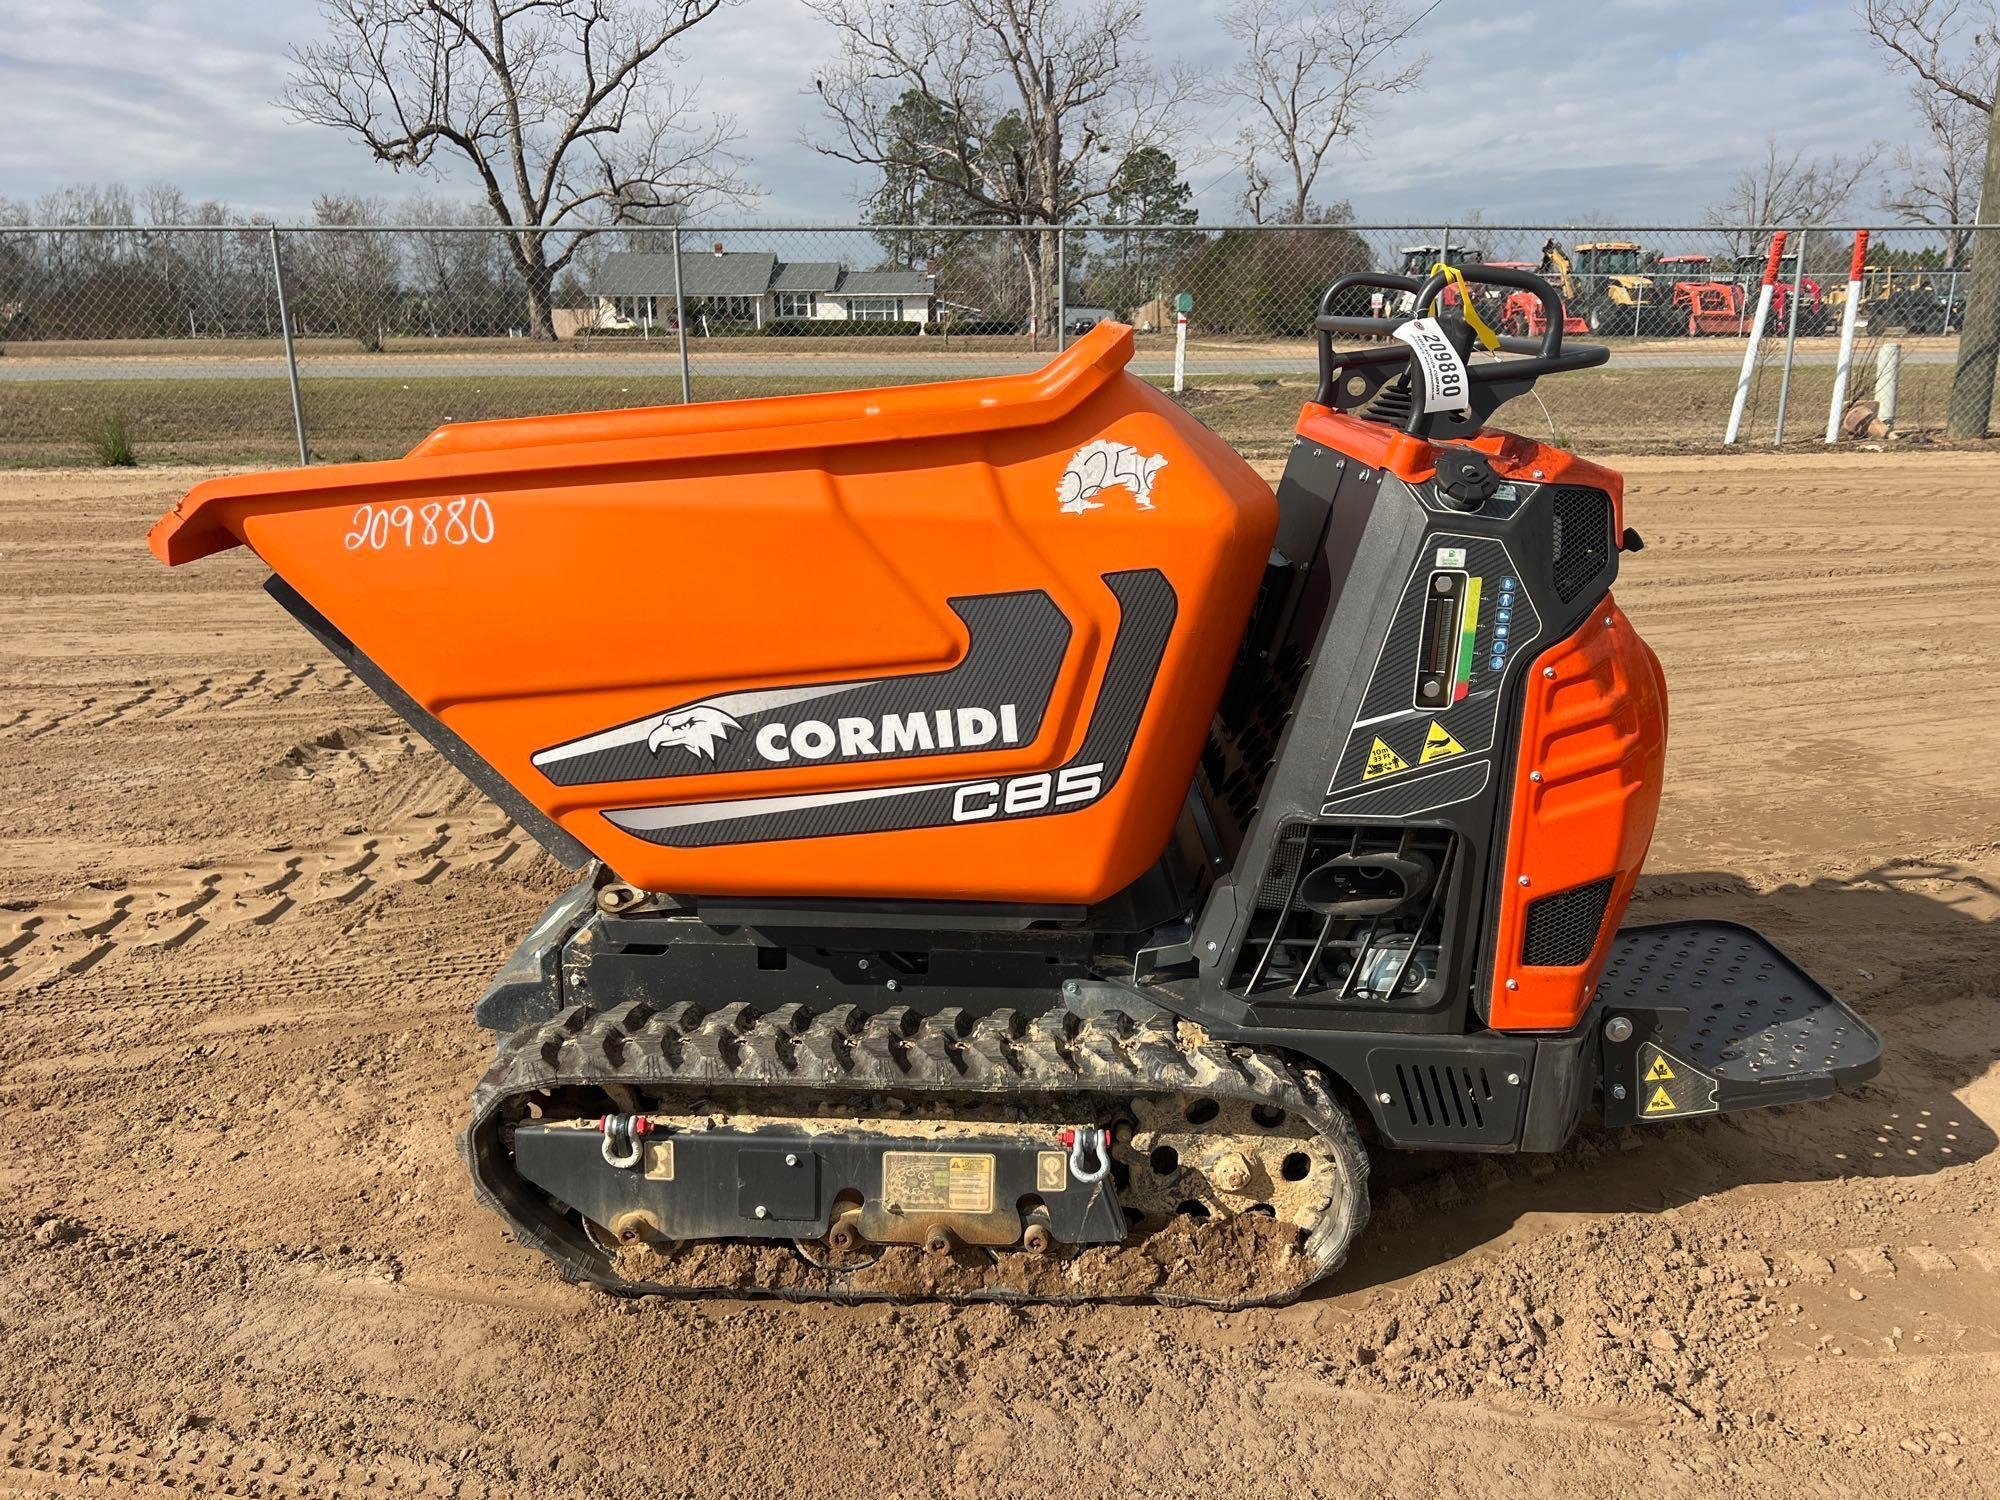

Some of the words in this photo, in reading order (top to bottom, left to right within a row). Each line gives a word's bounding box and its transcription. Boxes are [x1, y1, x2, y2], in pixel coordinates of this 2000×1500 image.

[1422, 334, 1462, 397] 209880
[1425, 348, 1436, 369] AUCTION
[344, 496, 495, 551] 209880
[755, 703, 1019, 763] CORMIDI
[1372, 748, 1388, 756] 10m
[950, 761, 1104, 824] C85
